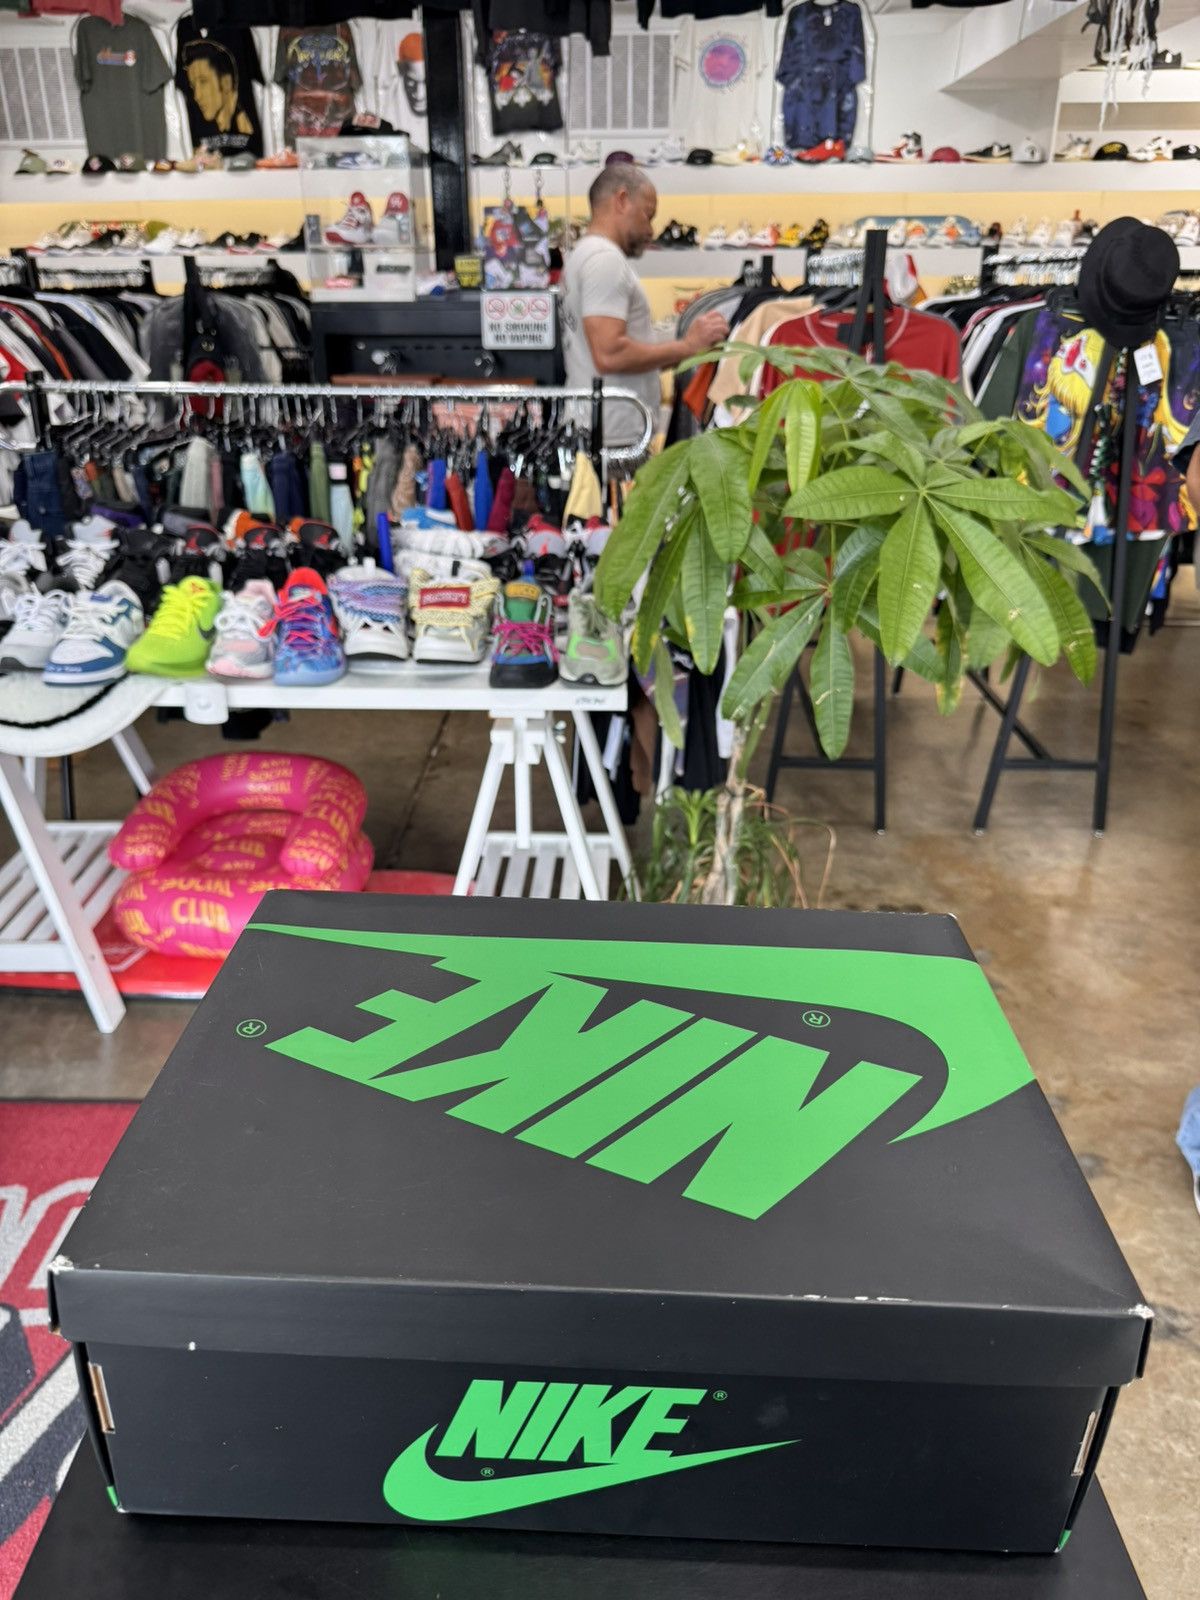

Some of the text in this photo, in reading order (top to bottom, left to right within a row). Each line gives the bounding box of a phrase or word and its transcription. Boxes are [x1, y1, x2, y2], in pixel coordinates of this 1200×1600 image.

[171, 896, 232, 934] CLUB
[264, 956, 923, 1220] NIKE
[435, 1379, 708, 1464] NIKE
